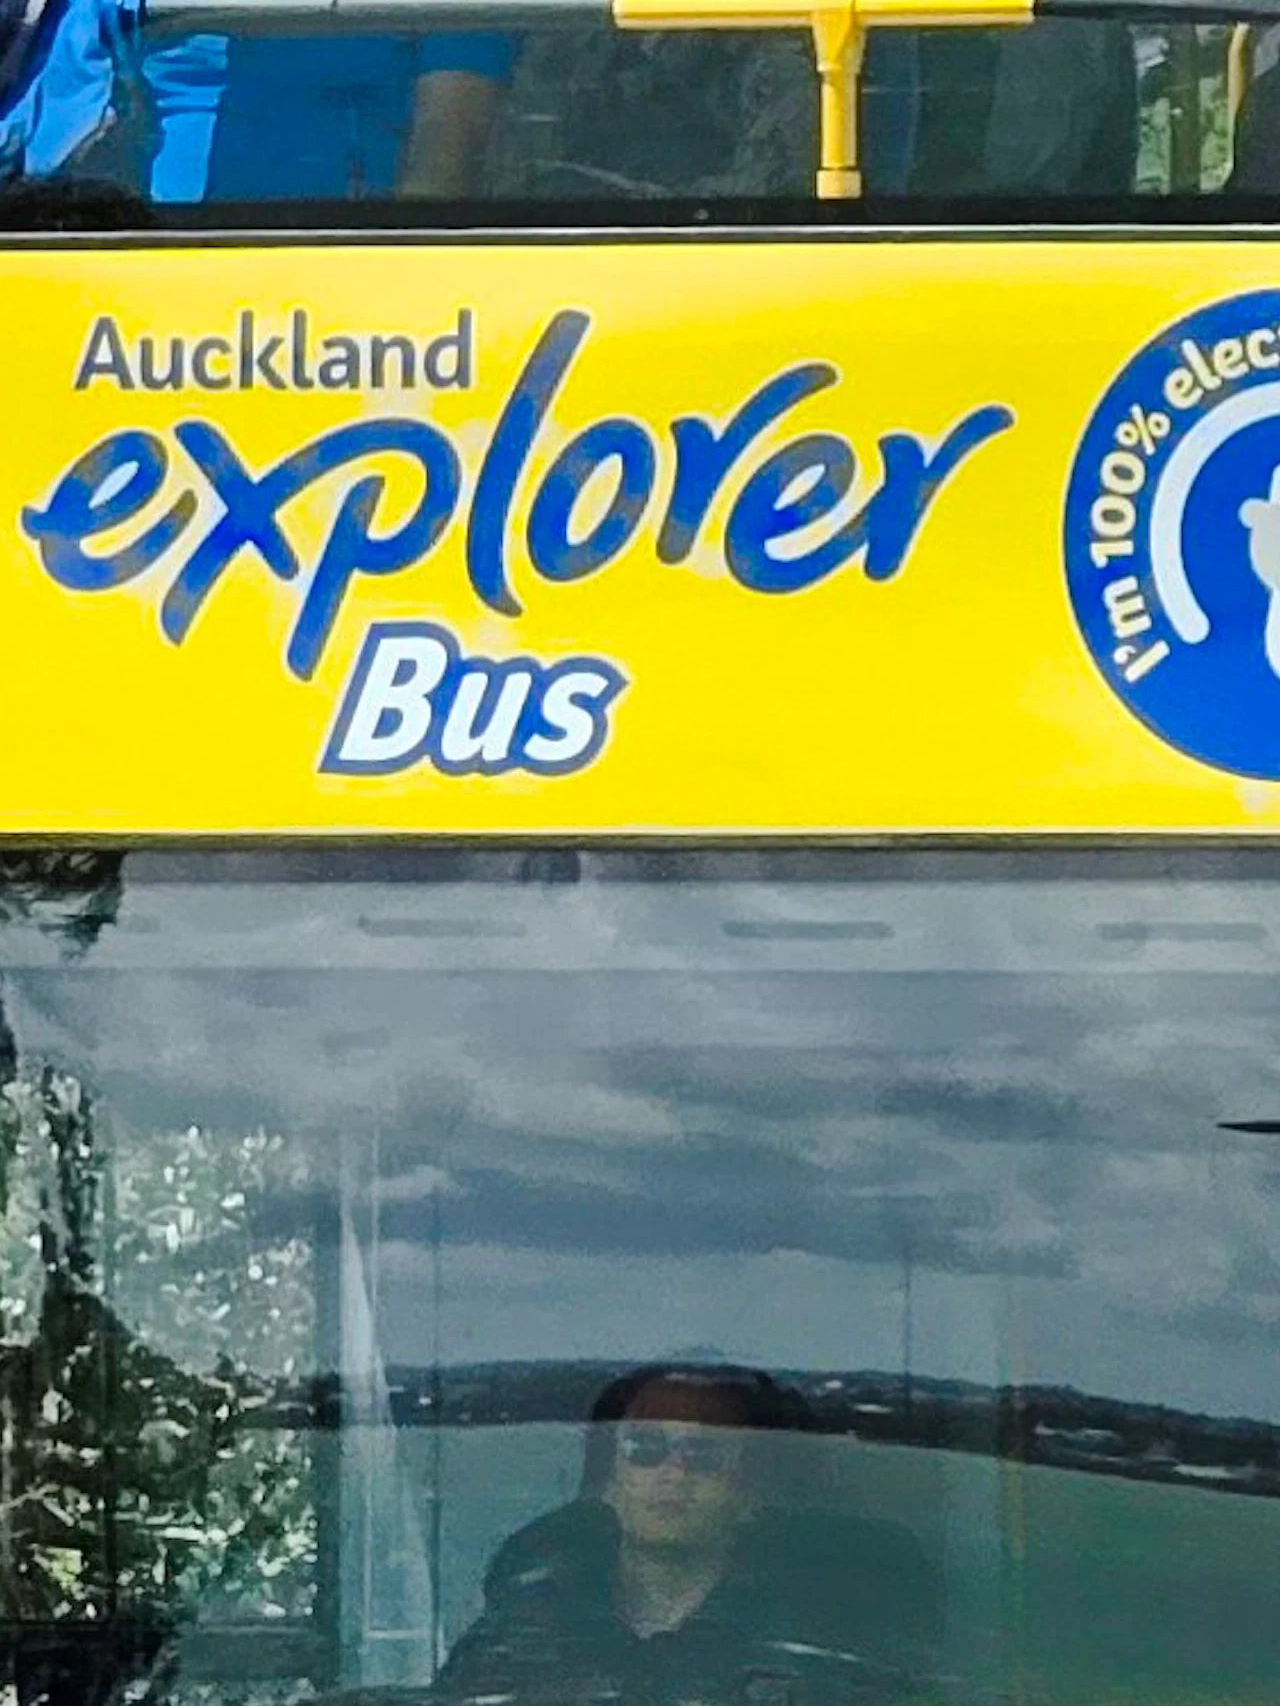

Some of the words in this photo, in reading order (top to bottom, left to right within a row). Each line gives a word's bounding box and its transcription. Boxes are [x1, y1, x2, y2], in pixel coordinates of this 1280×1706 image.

[73, 308, 472, 391] Auckland
[21, 308, 1017, 681] explorer
[1090, 403, 1172, 569] 100%
[328, 625, 620, 771] Bus
[1103, 576, 1171, 683] I'm
